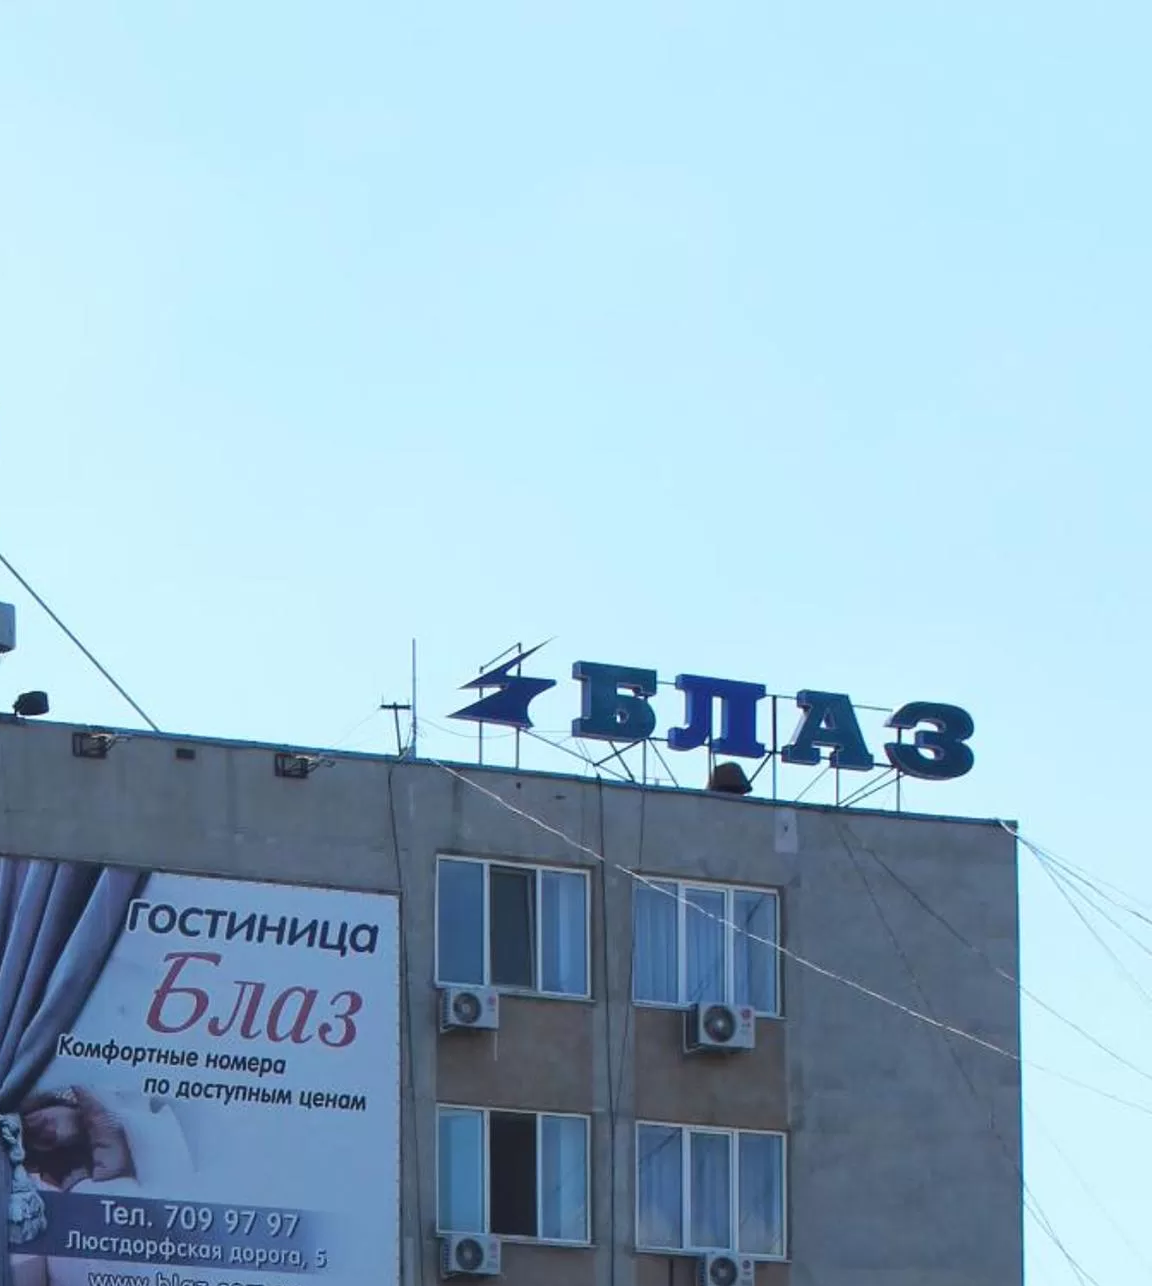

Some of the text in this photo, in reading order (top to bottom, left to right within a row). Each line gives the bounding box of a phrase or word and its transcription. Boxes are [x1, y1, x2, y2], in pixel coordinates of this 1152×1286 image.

[570, 660, 975, 781] БЛАЗ
[146, 952, 363, 1048] Блаз
[58, 1035, 286, 1078] Комфортные номера
[143, 1076, 366, 1112] по доступным ценам
[100, 1200, 299, 1238] Тел. 709 97 97
[65, 1230, 328, 1270] Люстдорфская дорога, 5
